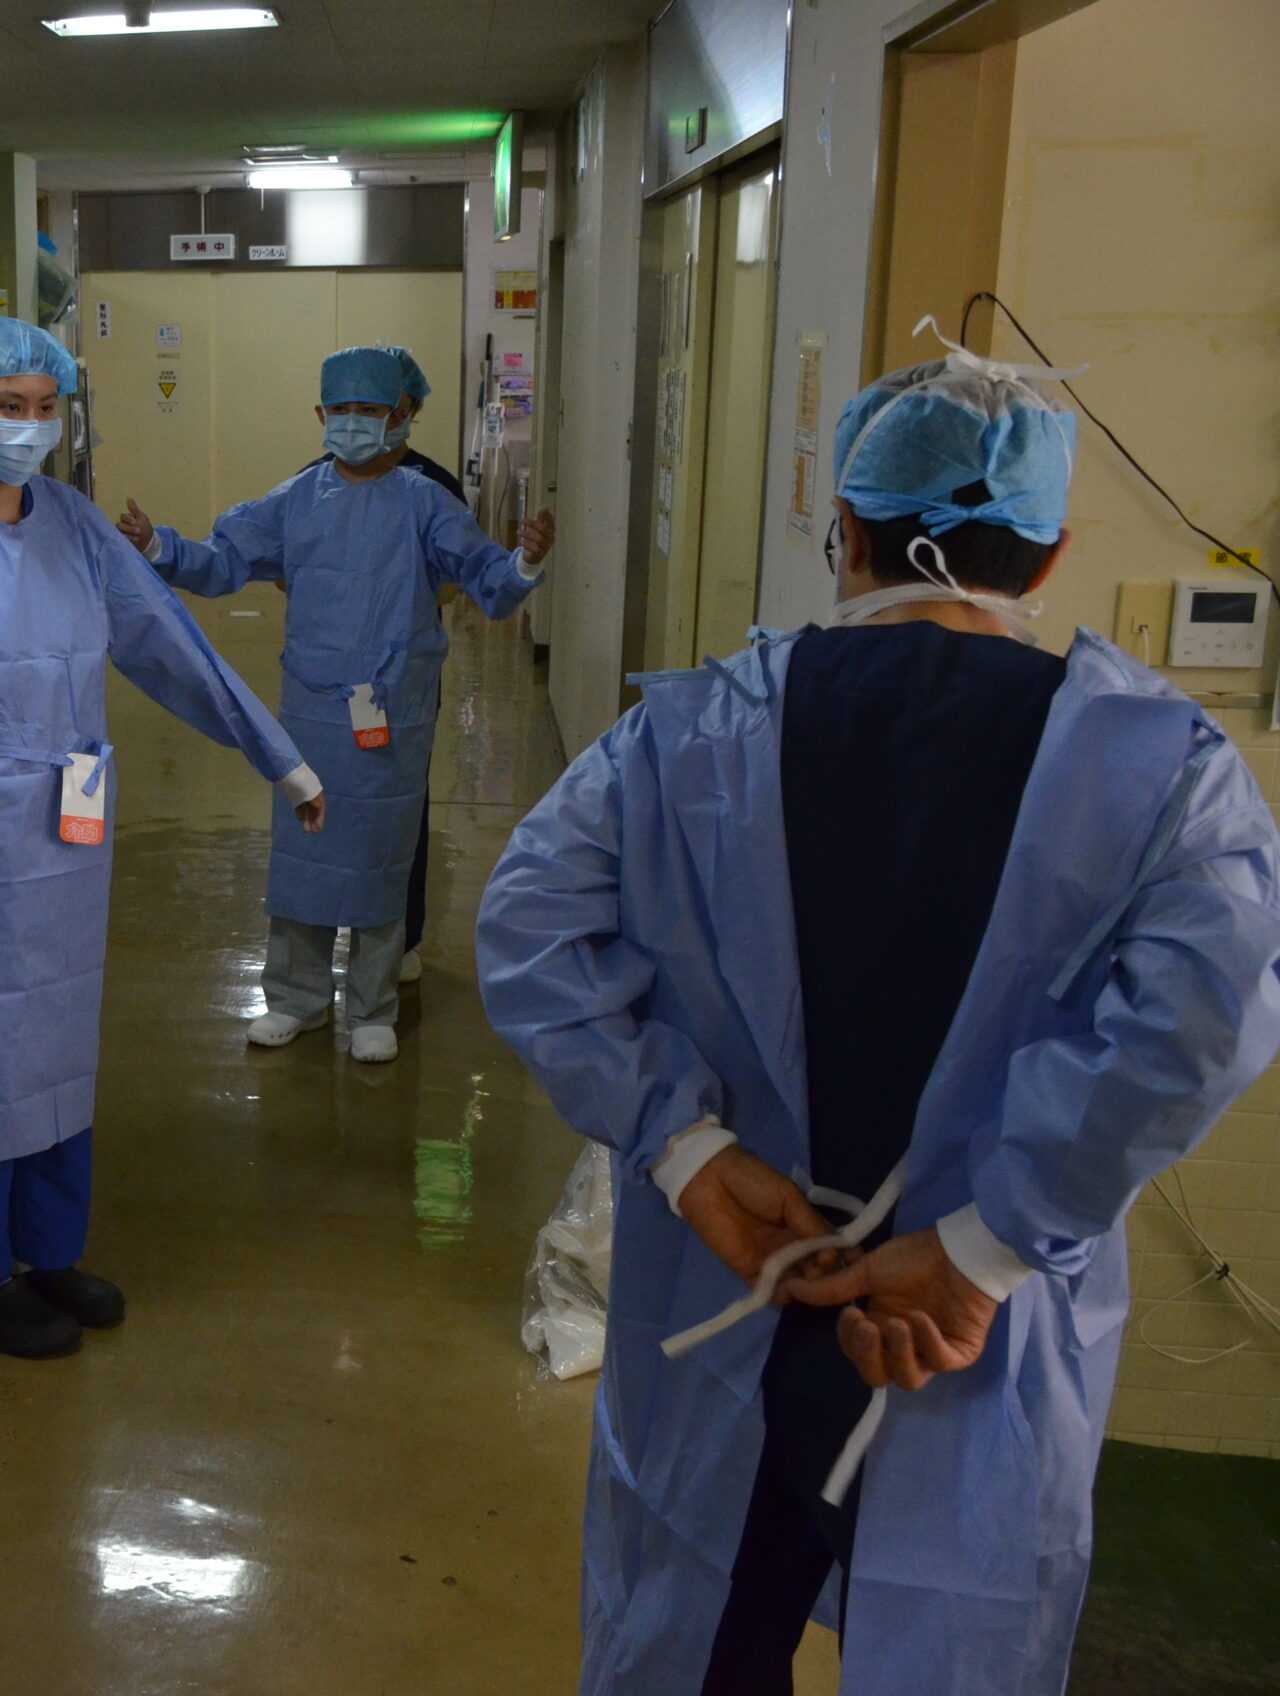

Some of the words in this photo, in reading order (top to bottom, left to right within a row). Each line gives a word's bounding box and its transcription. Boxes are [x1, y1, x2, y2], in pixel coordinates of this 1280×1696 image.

[181, 242, 225, 253] 手術中
[65, 821, 98, 842] 介助
